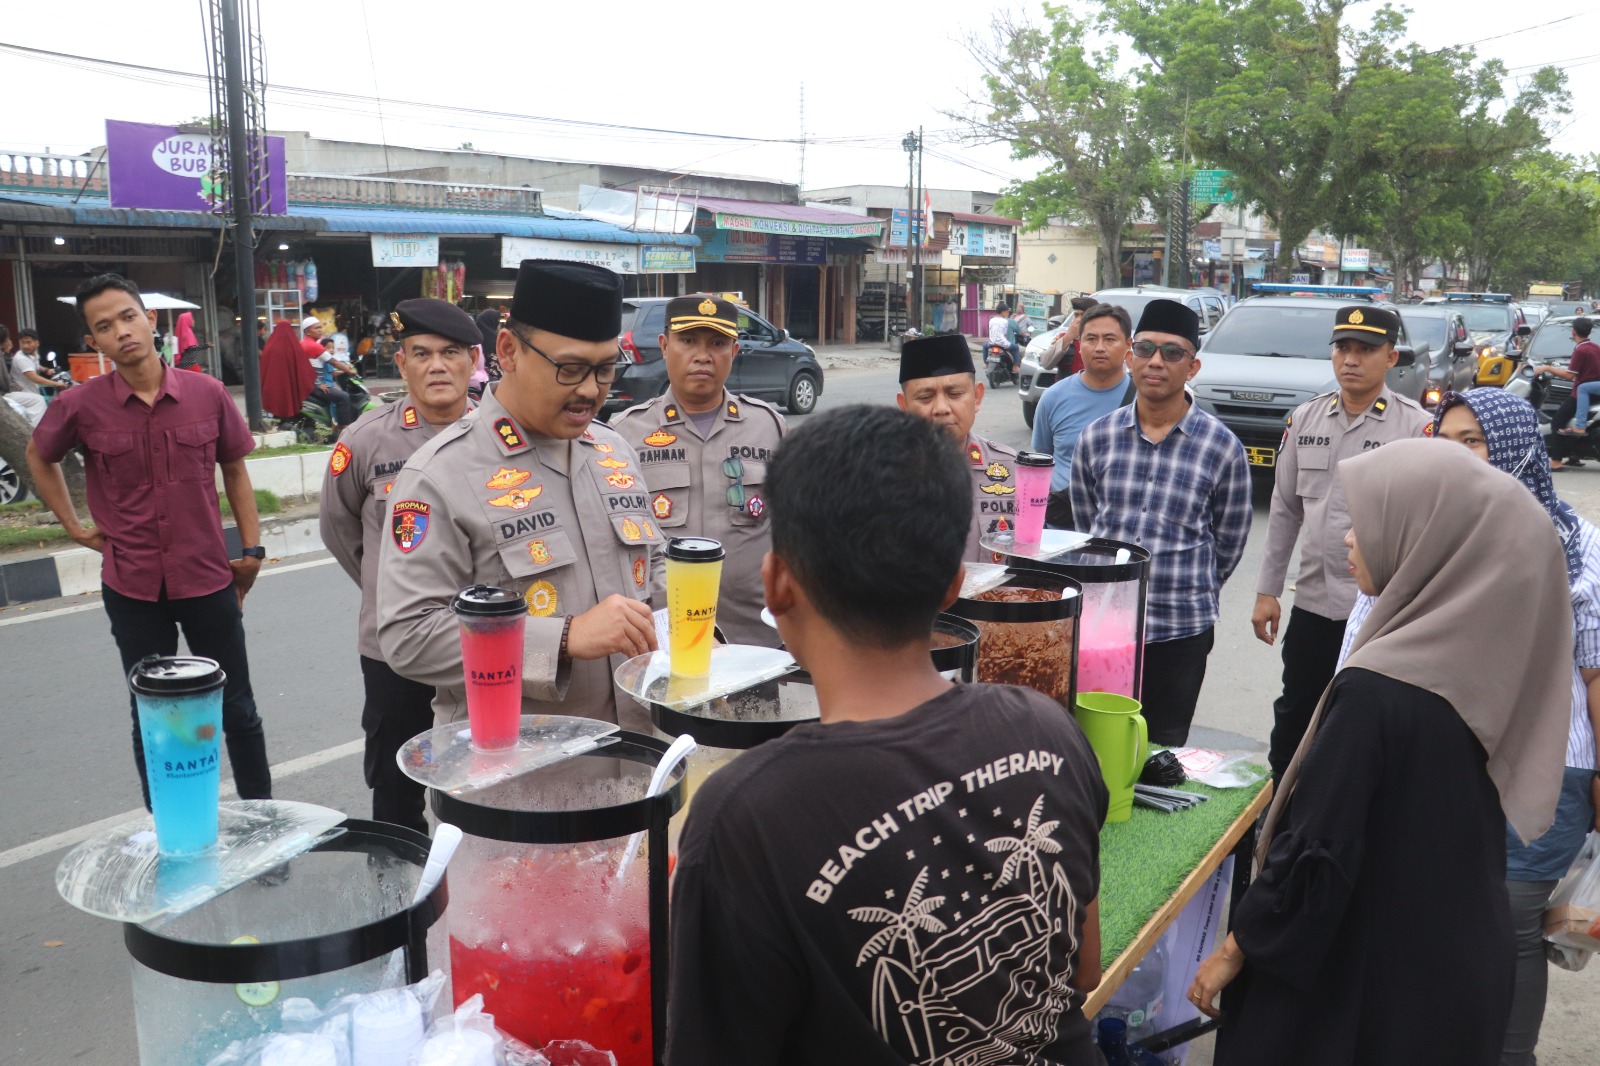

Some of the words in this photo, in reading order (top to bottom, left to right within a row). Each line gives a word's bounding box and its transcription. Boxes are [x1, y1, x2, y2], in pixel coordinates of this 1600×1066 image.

[723, 216, 752, 228] MADANI
[755, 220, 790, 232] KONVEKSI
[791, 224, 797, 232] &
[799, 224, 823, 235] DIGITAL
[825, 227, 854, 236] PRINTING
[854, 223, 877, 235] MADANI
[392, 241, 420, 258] DEP
[645, 251, 679, 261] SERVICE
[1233, 391, 1271, 401] ISUZU
[1363, 440, 1386, 449] PO
[640, 448, 686, 463] RAHMAN
[730, 446, 771, 460] POLRI
[395, 501, 428, 512] PROPAM
[609, 495, 647, 510] POLRI
[501, 511, 555, 539] DAVID
[805, 812, 900, 905] BEACH
[897, 781, 954, 823] TRIP
[960, 749, 1065, 794] THERAPY
